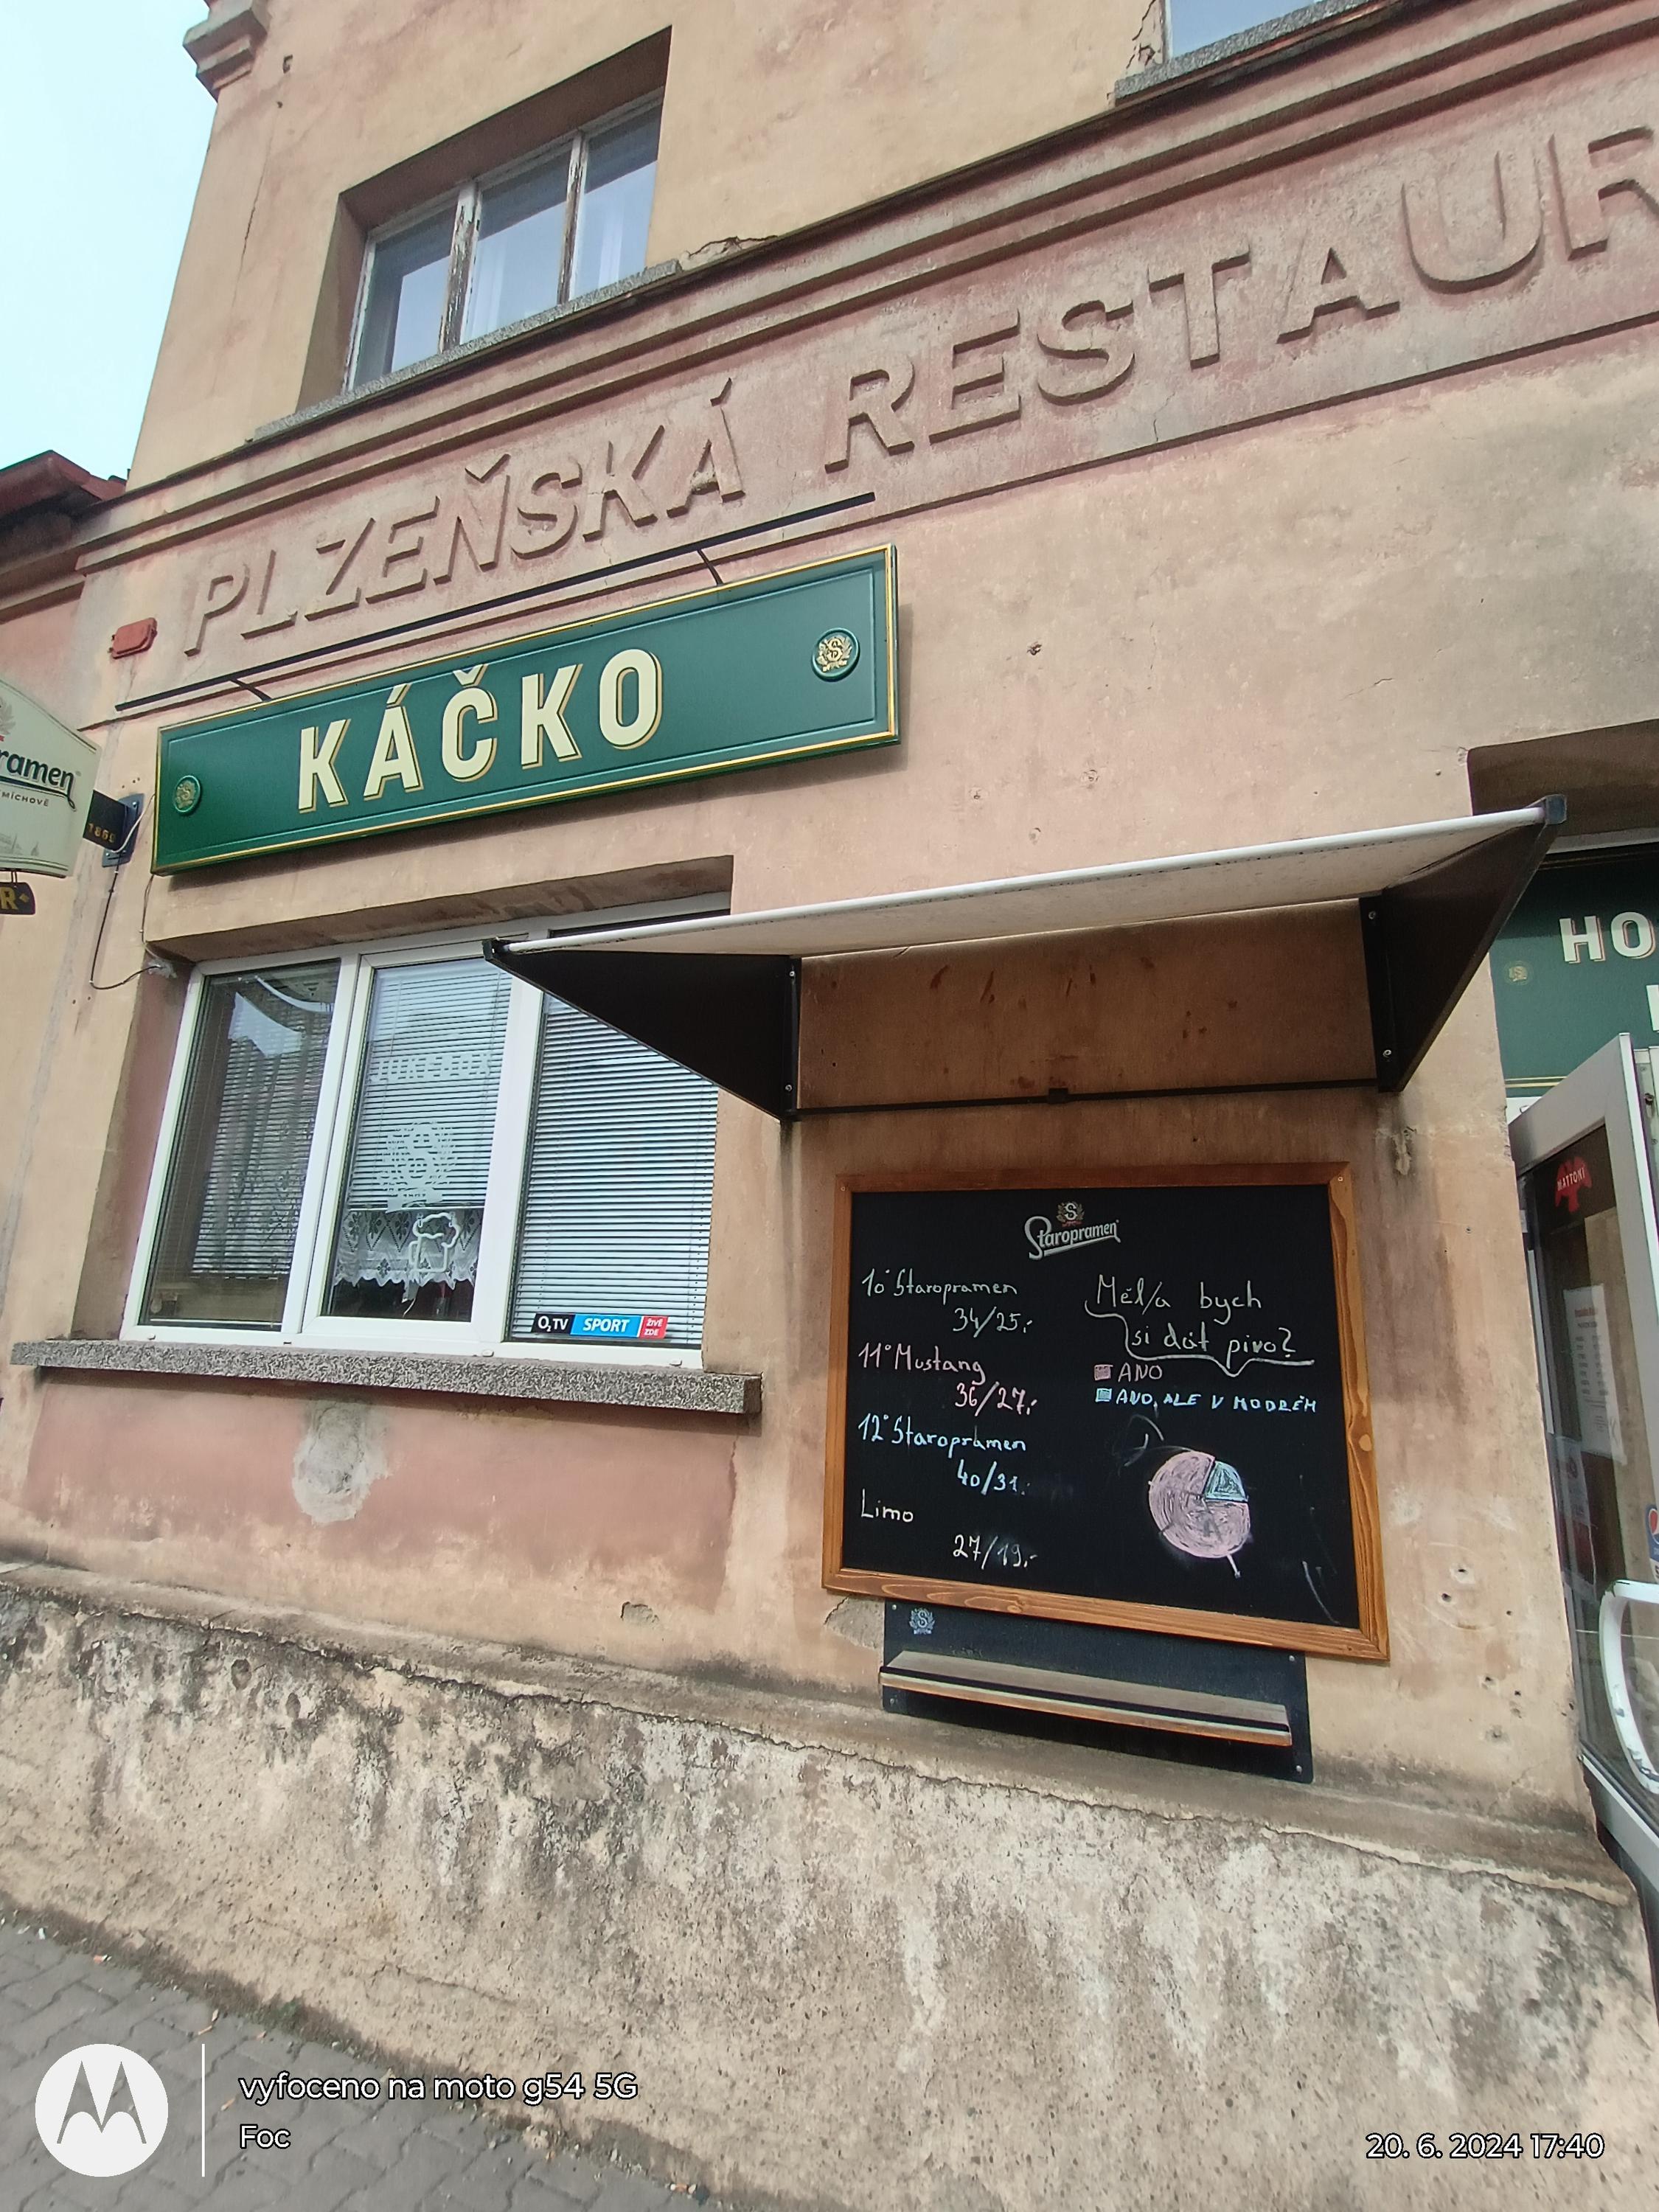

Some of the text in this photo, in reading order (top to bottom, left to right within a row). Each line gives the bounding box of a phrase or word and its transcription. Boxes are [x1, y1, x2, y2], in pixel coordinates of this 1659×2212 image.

[183, 376, 746, 657] PLZEŇSKÁ
[297, 648, 662, 814] KÁČKO
[1557, 1167, 1585, 1192] MATTONI
[1024, 1215, 1121, 1260] Staropramen
[893, 1267, 1018, 1306] Staropramen
[1096, 1274, 1262, 1326] Měl/a bych
[582, 1317, 630, 1333] SPORT
[644, 1328, 661, 1336] ZDE
[858, 1342, 987, 1386] 11° Mustang
[1131, 1325, 1150, 1346] si
[1225, 1326, 1296, 1370] pivo?
[1117, 1362, 1163, 1383] ANO
[1163, 1393, 1202, 1407] ALE
[1211, 1394, 1225, 1410] V
[858, 1413, 1027, 1459] 12° Staropramen
[860, 1487, 914, 1523] Limo
